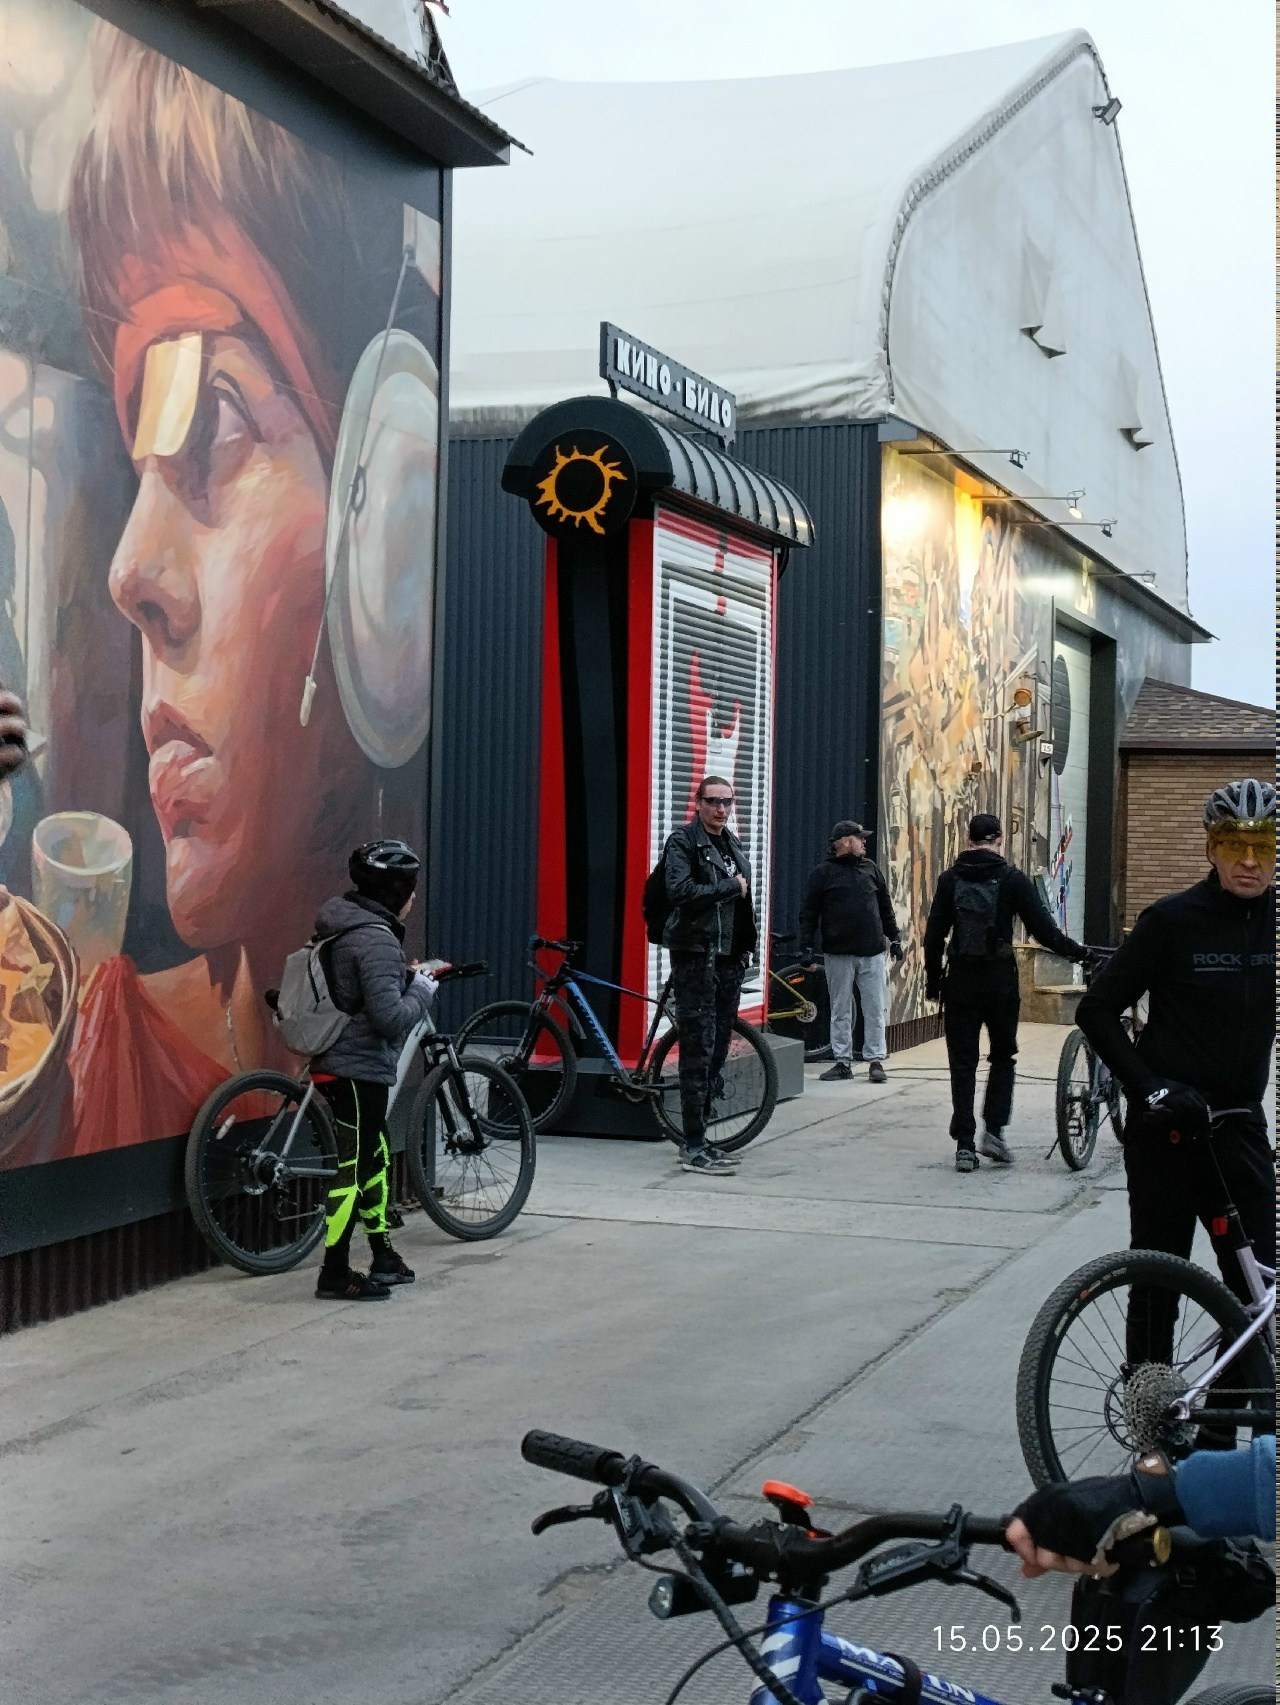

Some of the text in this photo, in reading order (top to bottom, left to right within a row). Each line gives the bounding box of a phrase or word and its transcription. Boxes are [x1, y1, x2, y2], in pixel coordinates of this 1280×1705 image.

[616, 337, 732, 428] КИНО БИЛО
[1192, 953, 1243, 966] ROCK
